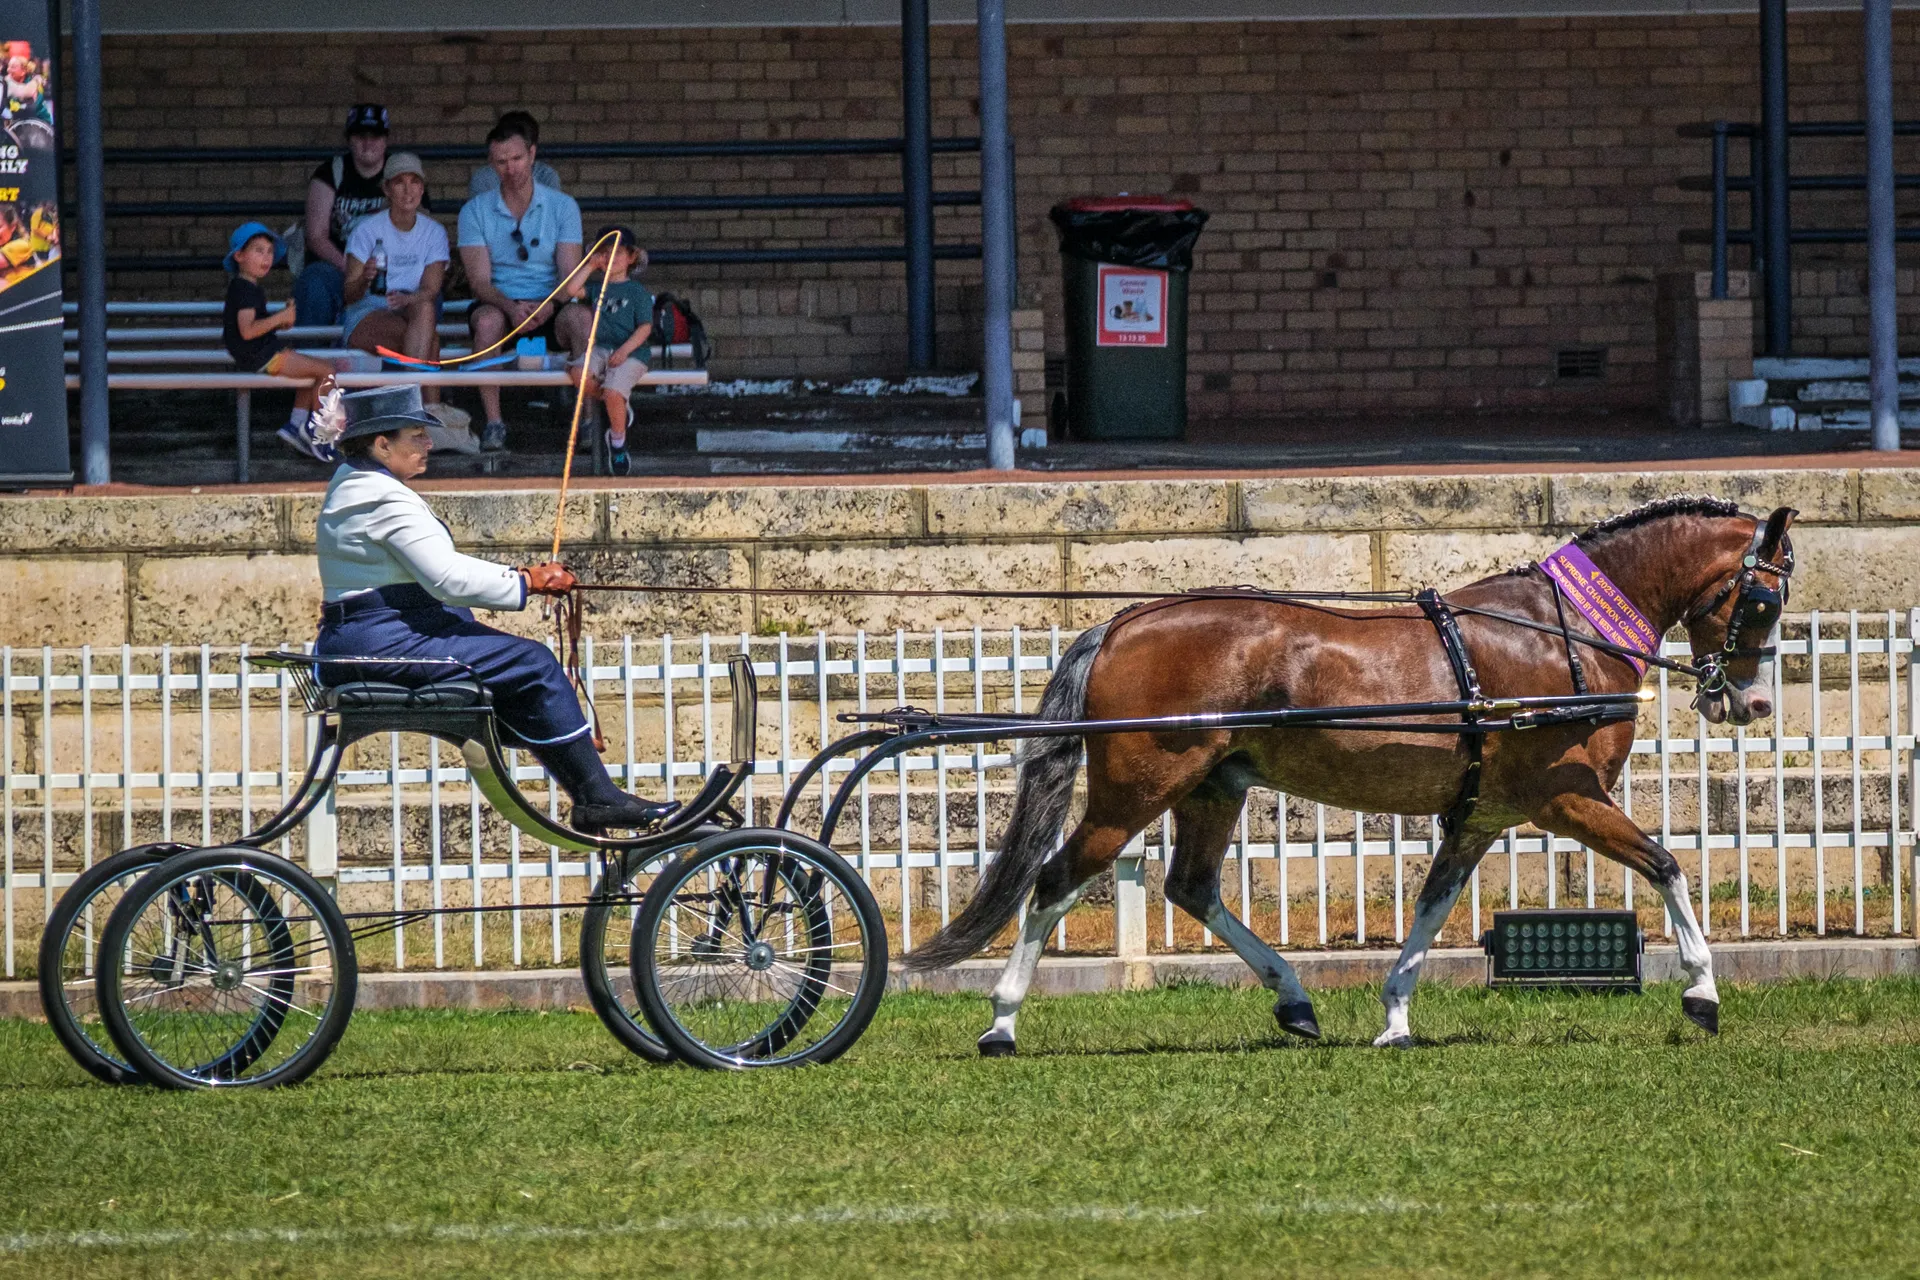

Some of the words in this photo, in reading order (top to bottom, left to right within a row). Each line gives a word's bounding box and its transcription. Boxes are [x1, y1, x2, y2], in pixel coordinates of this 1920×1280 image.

[1558, 556, 1588, 587] SUPREME
[1586, 586, 1620, 622] CHAMPION
[1619, 621, 1650, 653] CARRIAGE
[1559, 576, 1586, 604] SPONSORED
[1583, 602, 1592, 611] BY
[1590, 609, 1602, 621] THE
[1599, 618, 1613, 633] WEST
[1597, 578, 1615, 596] 2025
[1614, 595, 1637, 620] PERTH
[1636, 619, 1657, 644] ROYAL
